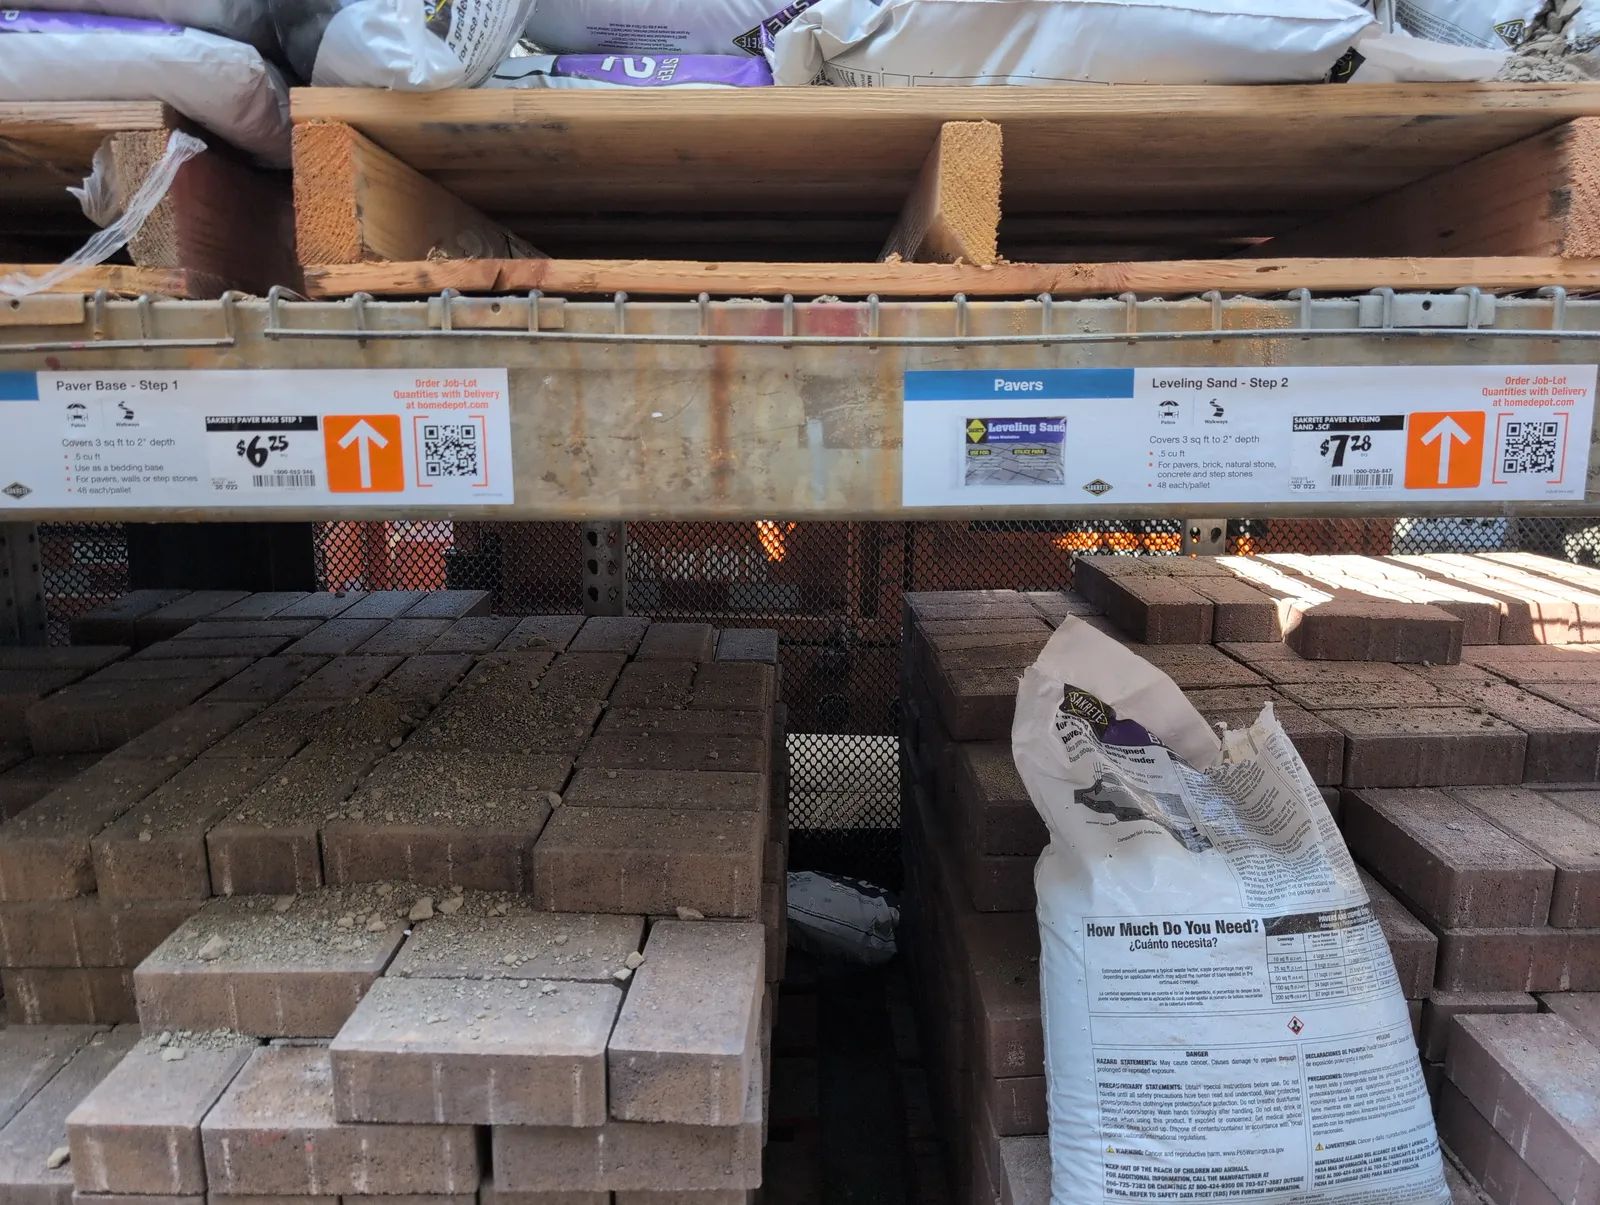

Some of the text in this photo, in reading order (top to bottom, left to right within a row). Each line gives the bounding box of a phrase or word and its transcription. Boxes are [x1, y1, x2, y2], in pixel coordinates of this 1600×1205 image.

[657, 57, 679, 81] STEP
[415, 379, 477, 387] Order Job-Lot
[994, 378, 1044, 392] Pavers
[1152, 378, 1203, 390] Leveling
[1206, 378, 1237, 388] Sand
[1249, 378, 1278, 389] Step
[1281, 378, 1289, 388] 2
[1505, 376, 1566, 385] Order Job-Lot
[56, 380, 91, 391] Paver
[95, 380, 127, 391] Base
[139, 380, 168, 392] Step
[173, 380, 178, 390] 1
[393, 390, 499, 399] Quantities with Delivery
[1482, 387, 1587, 397] Quantities with Delivery
[406, 401, 489, 410] at homedepot.com
[1504, 398, 1574, 408] homedepot.com
[207, 416, 236, 424] SAKRETE
[988, 422, 1036, 434] Leveling
[1039, 422, 1065, 432] Sand
[62, 438, 93, 447] Covers
[95, 438, 101, 447] 3
[104, 440, 115, 449] sq
[117, 438, 124, 446] ft
[149, 438, 175, 448] depth
[1150, 436, 1179, 444] Covers
[1190, 437, 1201, 445] sq
[1235, 435, 1260, 444] depth
[75, 464, 90, 472] Use
[110, 464, 143, 472] bedding
[1202, 461, 1223, 469] brick,
[1253, 461, 1277, 469] stone,
[76, 475, 88, 483] For
[153, 475, 170, 484] step
[1209, 471, 1226, 479] step
[89, 486, 131, 495] each/pallet
[1168, 481, 1210, 490] each/pallet
[1070, 692, 1105, 724] SAKRETE
[1056, 721, 1068, 731] for
[1087, 919, 1259, 937] How Much Do You Need?
[1129, 937, 1218, 951] ¿Cuánto necesita?
[1219, 1173, 1262, 1181] MANUFACTURER
